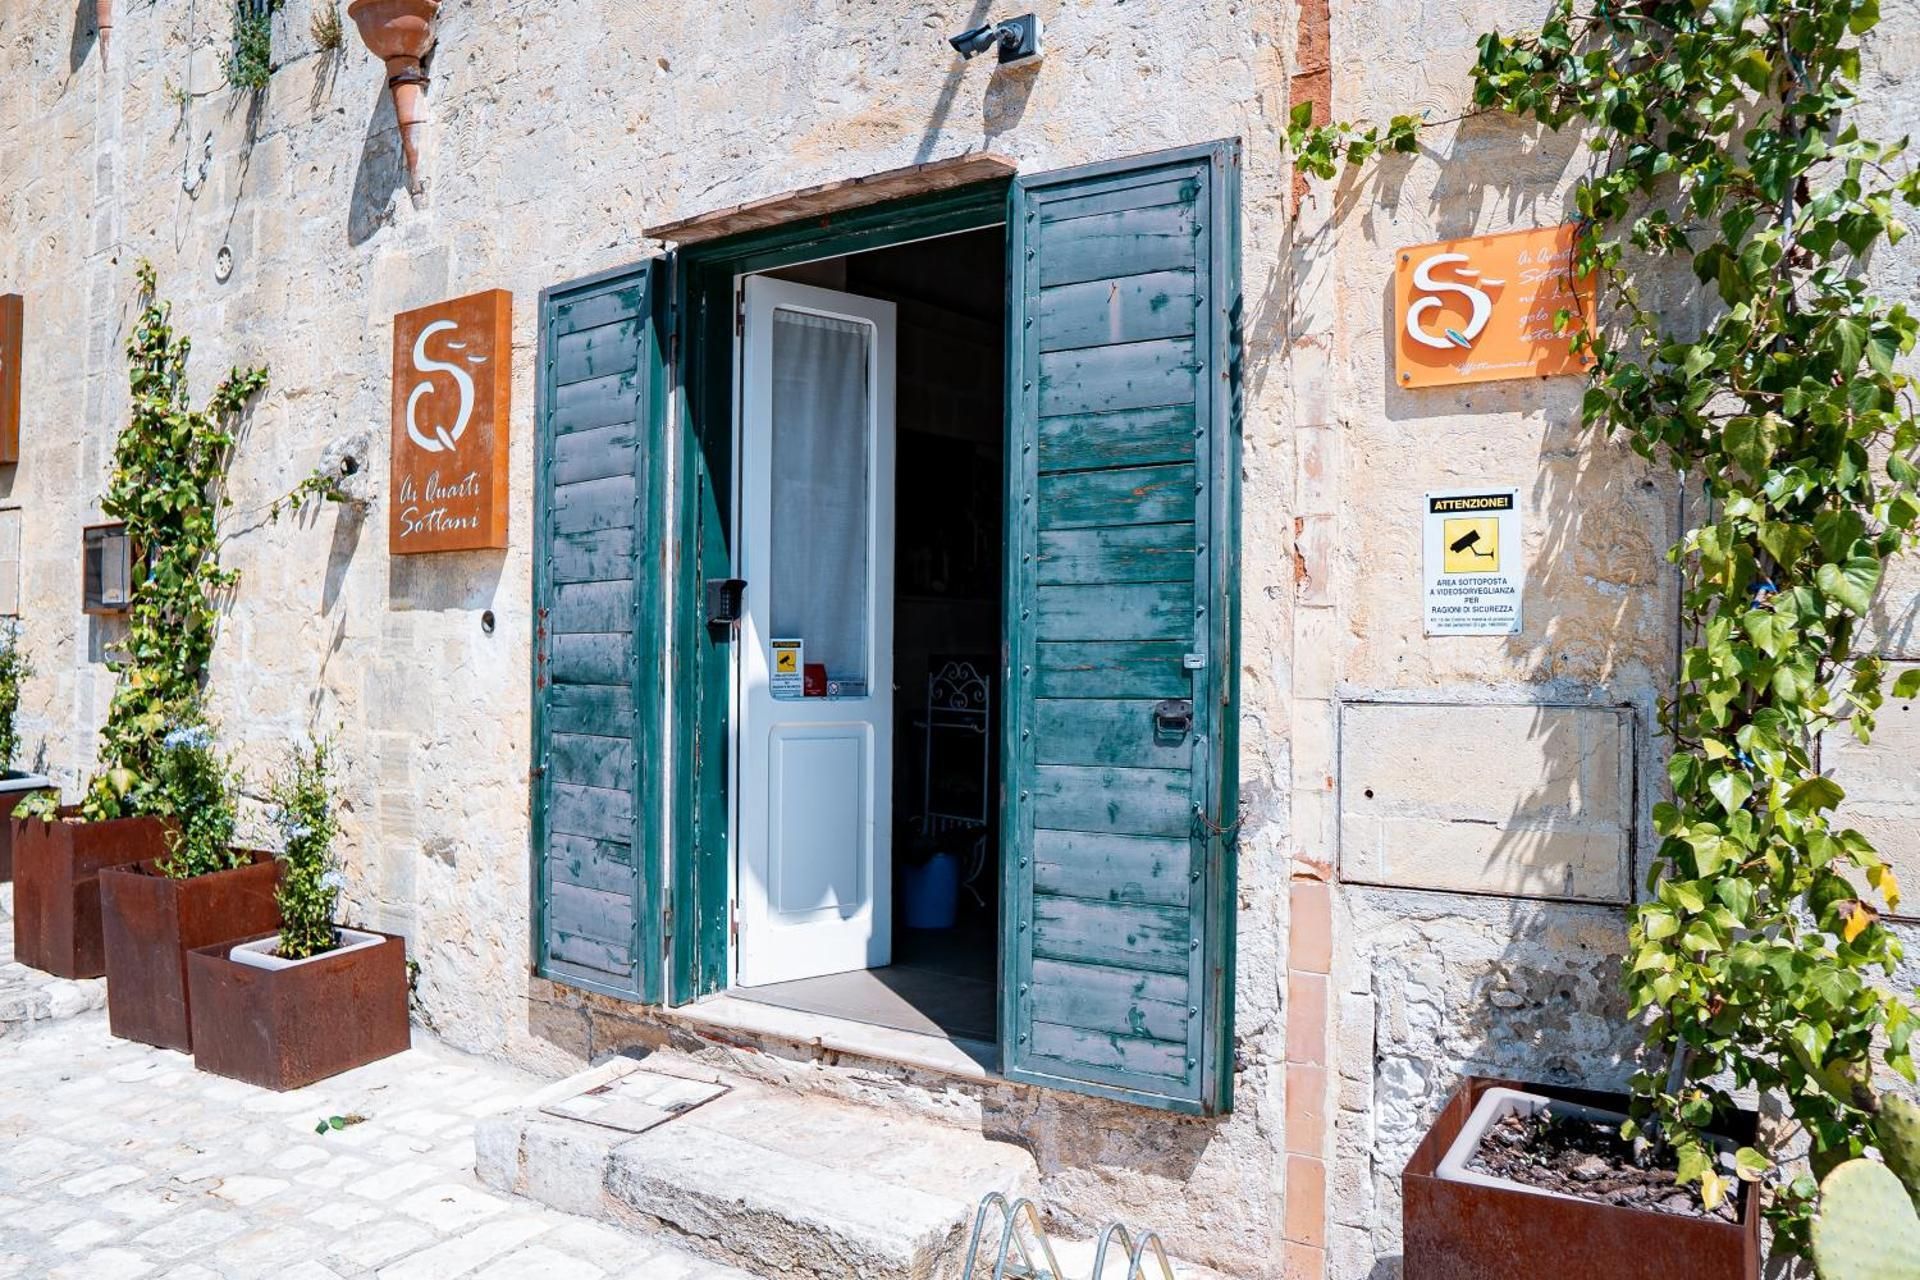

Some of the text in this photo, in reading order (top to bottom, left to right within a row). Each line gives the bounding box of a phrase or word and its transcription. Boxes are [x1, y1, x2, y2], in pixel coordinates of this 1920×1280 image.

[425, 470, 481, 504] Quarti
[1434, 497, 1508, 511] ATTENZIONE!
[400, 506, 480, 537] Sottani
[1458, 577, 1508, 586] SOTTOPOSTA
[1437, 586, 1516, 596] VIDEOSORVEGLIANZA
[1431, 604, 1514, 614] RAGIONI DI SICUREZZA
